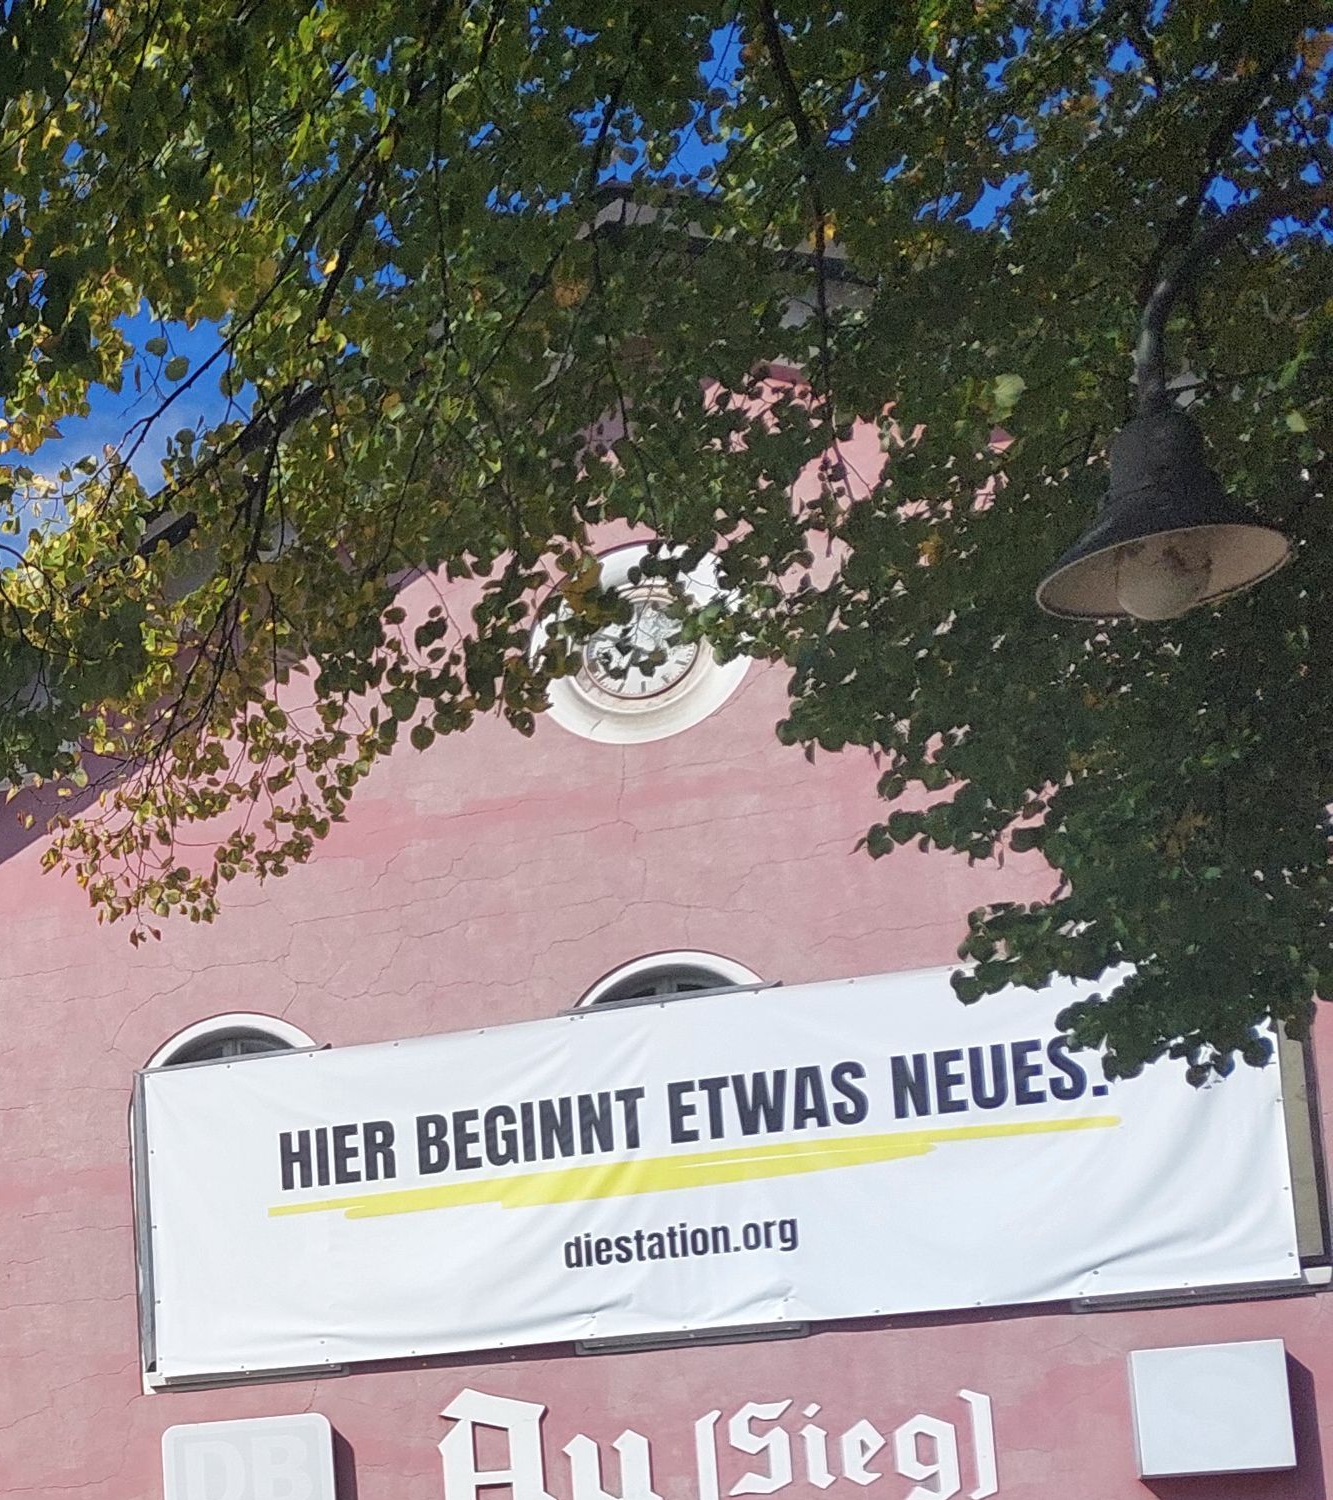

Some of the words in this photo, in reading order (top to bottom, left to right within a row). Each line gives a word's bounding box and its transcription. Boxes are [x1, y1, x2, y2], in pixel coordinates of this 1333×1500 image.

[279, 1120, 397, 1191] HIER
[416, 1086, 645, 1176] BEGINNT
[667, 1060, 870, 1144] ETWAS
[889, 1034, 1109, 1120] NEUES.
[563, 1217, 799, 1269] diestation.org
